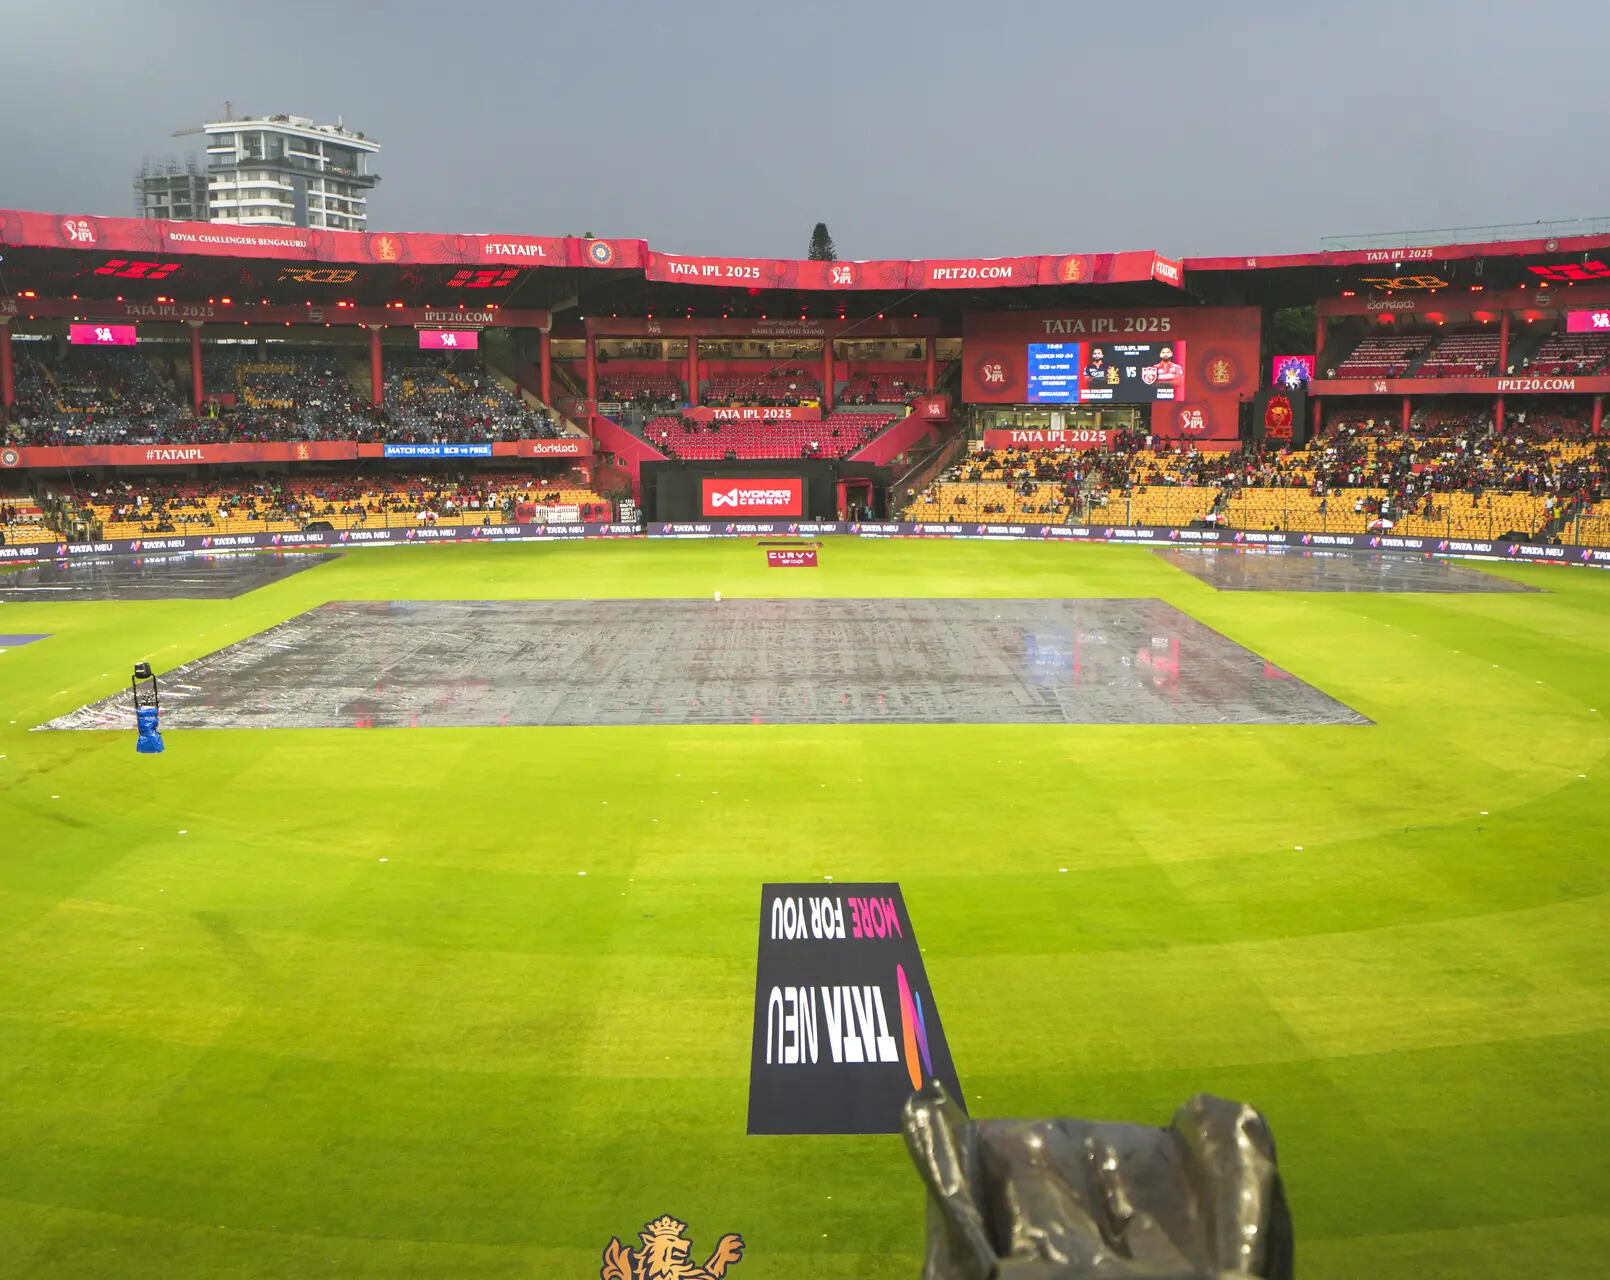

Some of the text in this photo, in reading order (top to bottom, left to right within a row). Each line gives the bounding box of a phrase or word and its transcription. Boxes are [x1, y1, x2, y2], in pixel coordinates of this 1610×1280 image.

[78, 232, 96, 242] IPL
[170, 233, 306, 248] ROYAL CHALLENGERS BENGALURU
[485, 243, 546, 257] #TATAIPL
[1366, 249, 1433, 261] TATA IPL 2025
[668, 262, 760, 279] TATA IPL 2025
[933, 266, 1012, 280] IPLT20.COM
[839, 275, 852, 285] IPL
[124, 305, 214, 317] TATA IPL 2025
[425, 311, 493, 322] IPLT20.COM
[1042, 317, 1171, 334] TATA IPL 2025
[1126, 366, 1137, 378] VS
[1497, 379, 1575, 391] IPLT20.COM
[713, 409, 792, 419] TATA IPL 2025
[1190, 420, 1205, 428] IPL
[1010, 430, 1107, 442] TATA IPL 2025
[533, 443, 578, 454] ಬೆಂಗಳೂರು
[145, 449, 204, 460] #TATAIPL
[738, 490, 792, 498] WONDER
[482, 528, 503, 536] TATA
[546, 526, 584, 534] TATA NEU
[987, 526, 1008, 534] TATA
[1051, 528, 1090, 536] TATA NEU
[1137, 530, 1154, 538] NEU
[282, 534, 324, 542] TATA NEU
[350, 532, 372, 540] TATA
[1203, 532, 1219, 540] NEU
[1246, 534, 1286, 542] TATA NEU
[1313, 536, 1335, 544] TATA
[142, 540, 186, 550] TATA NEU
[213, 538, 236, 546] TATA
[1382, 538, 1422, 548] TATA NEU
[1450, 542, 1492, 552] TATA NEU
[0, 548, 38, 556] ATA NEU
[68, 544, 113, 553] TATA NEU
[1521, 546, 1564, 556] TATA NEU
[771, 897, 903, 939] MORE FOR YOU
[766, 985, 899, 1064] TATA NEU
